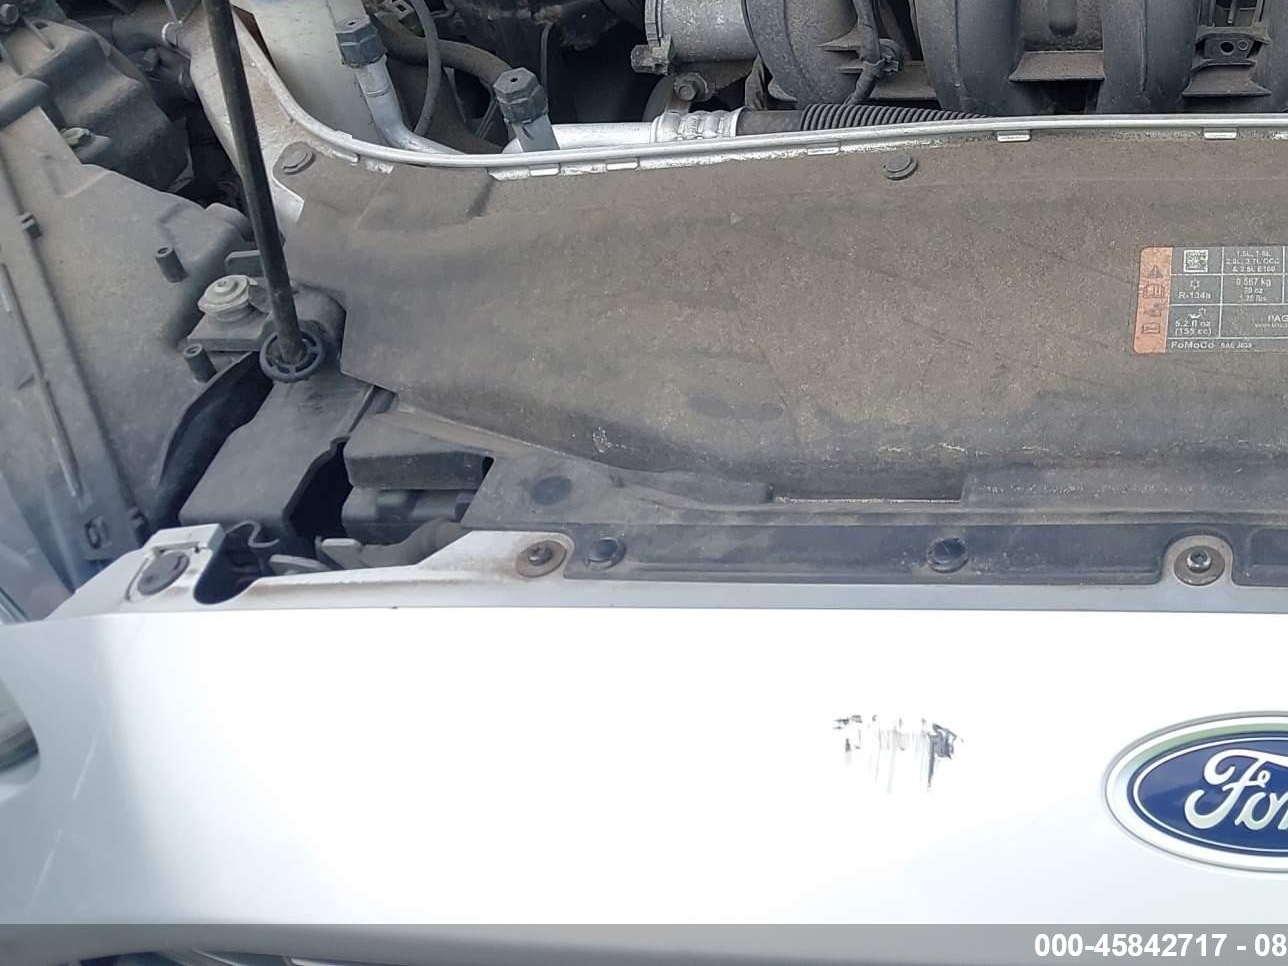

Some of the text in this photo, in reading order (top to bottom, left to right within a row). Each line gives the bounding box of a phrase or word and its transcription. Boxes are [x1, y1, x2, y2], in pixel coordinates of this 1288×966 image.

[1260, 277, 1272, 287] kg
[1267, 314, 1288, 322] PAG
[1171, 341, 1215, 350] FoMoCo
